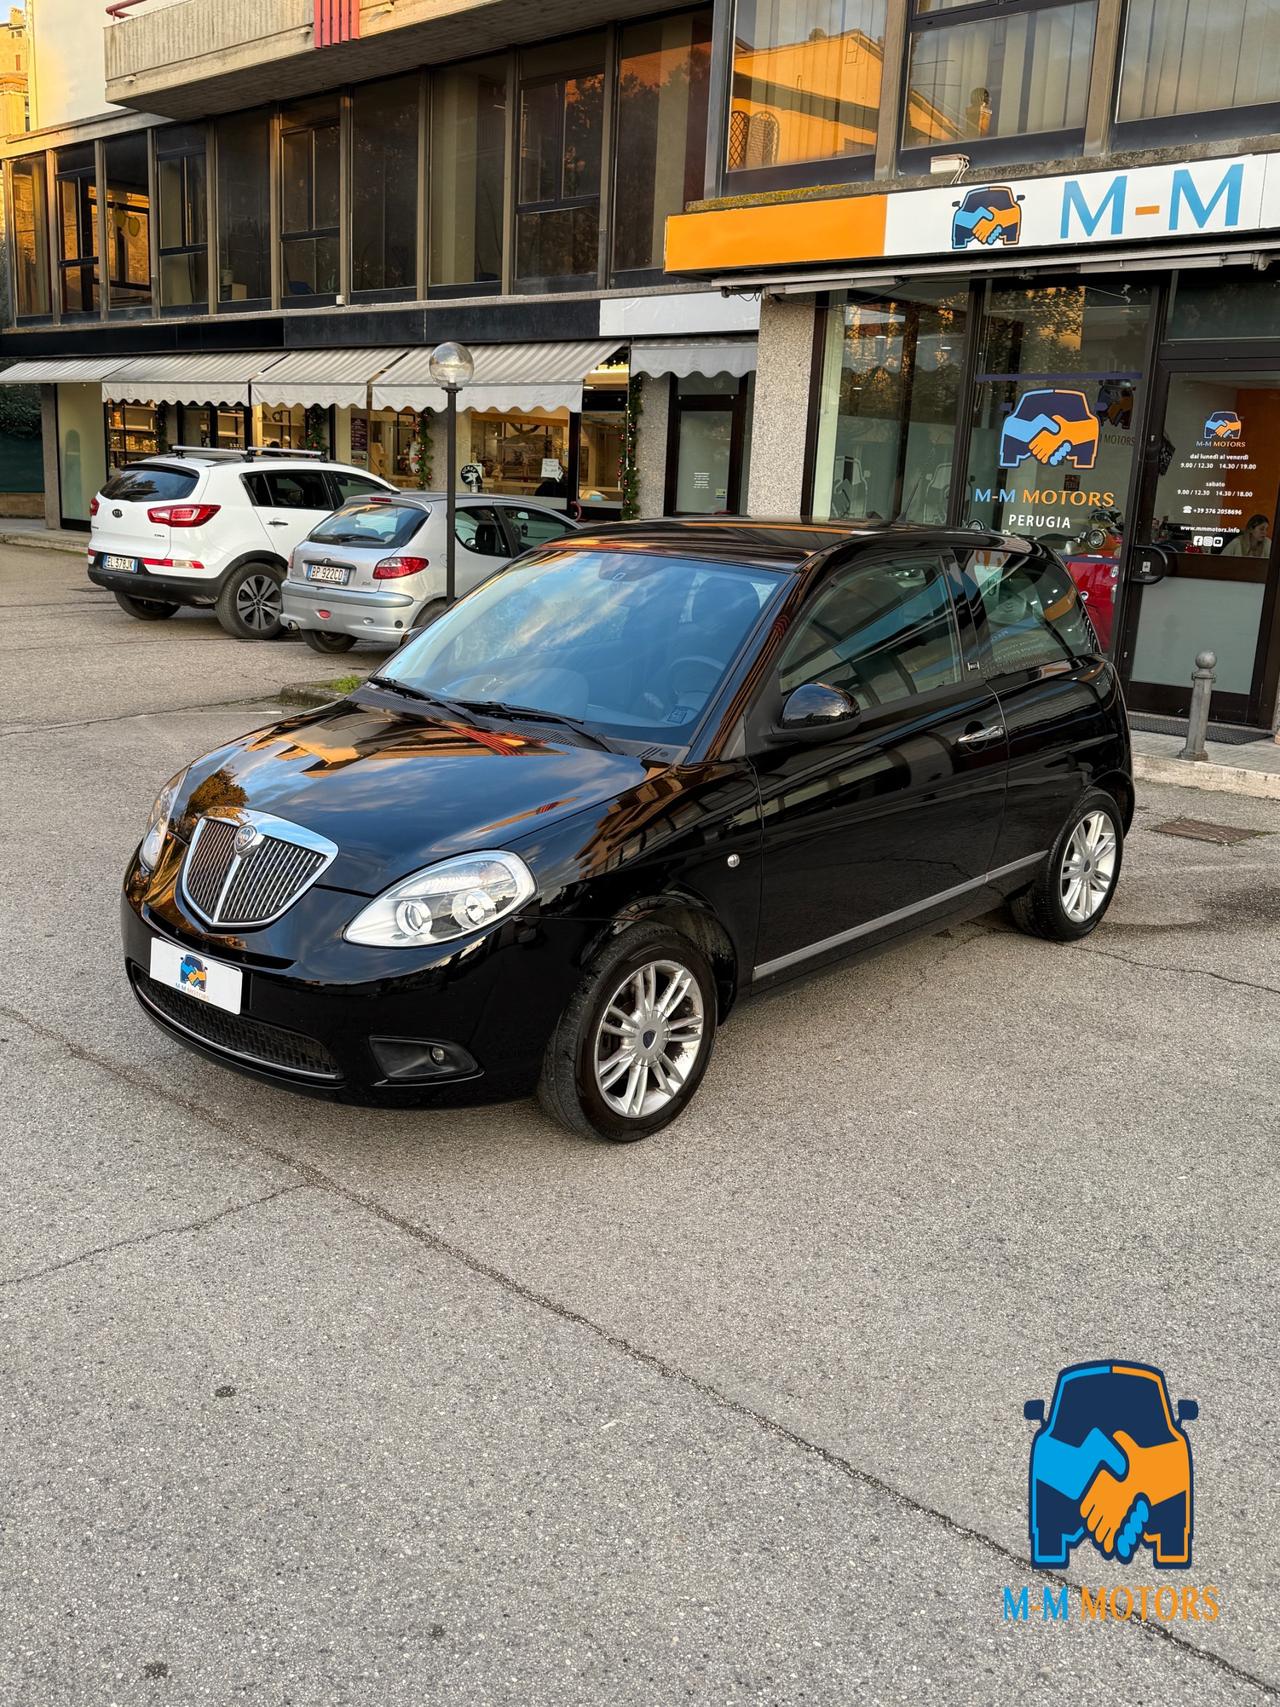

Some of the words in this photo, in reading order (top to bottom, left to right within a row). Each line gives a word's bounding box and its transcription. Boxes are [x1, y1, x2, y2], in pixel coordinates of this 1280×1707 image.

[1060, 164, 1244, 239] M-M
[975, 488, 1016, 503] M-M
[1023, 489, 1115, 507] MOTORS
[1008, 514, 1071, 529] PERUGIA
